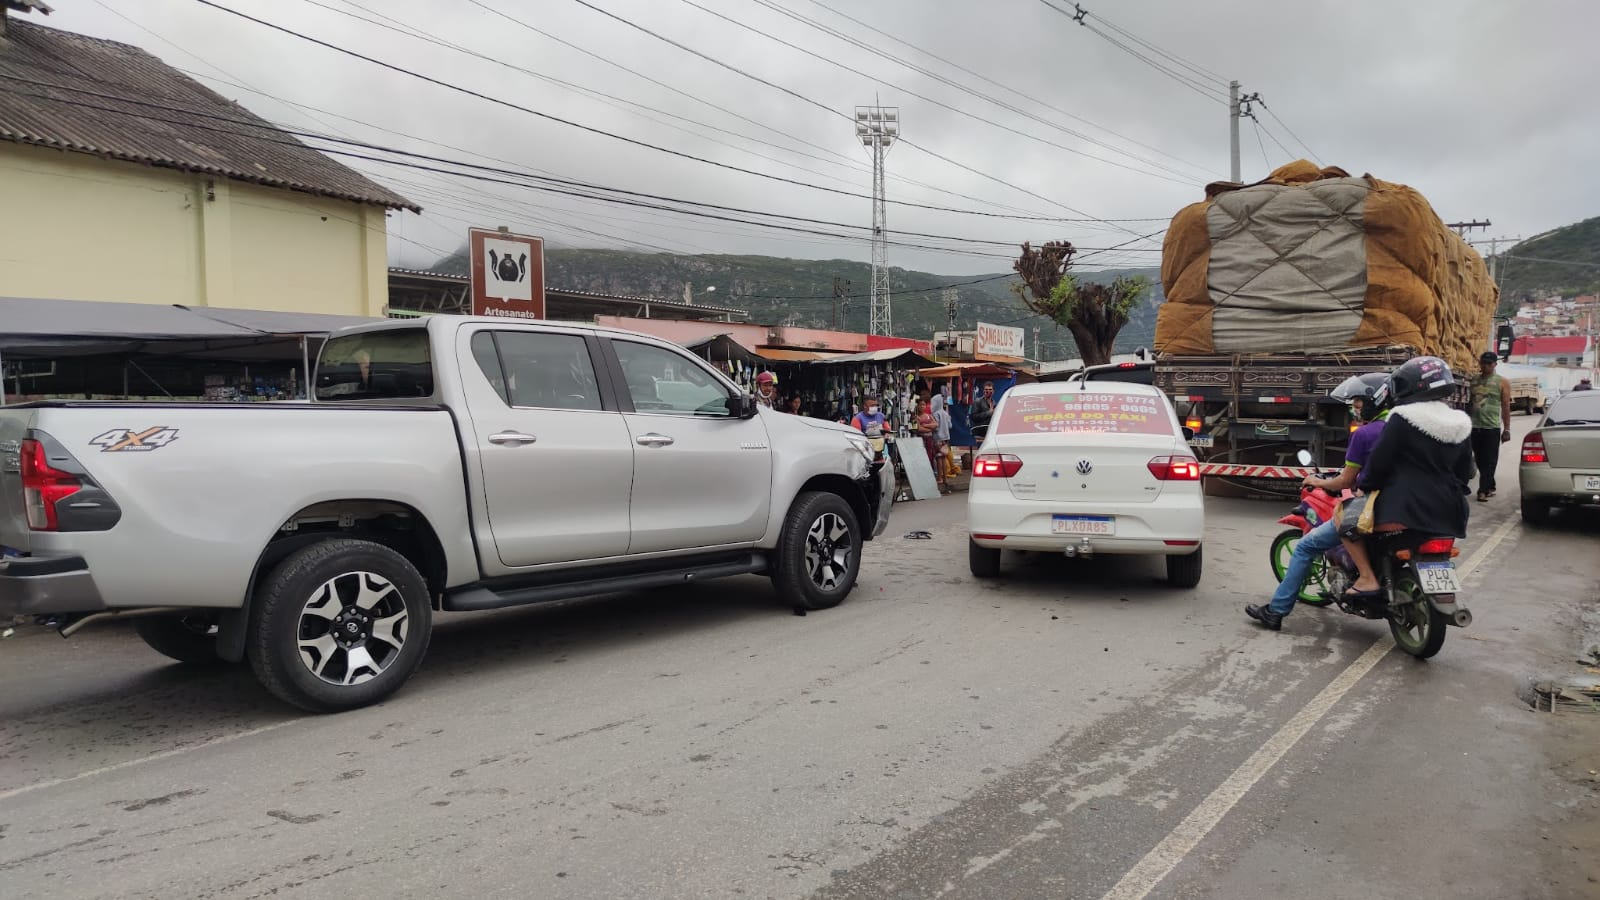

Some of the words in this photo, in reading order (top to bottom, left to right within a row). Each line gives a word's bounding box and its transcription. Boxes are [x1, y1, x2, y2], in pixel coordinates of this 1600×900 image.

[484, 306, 535, 319] Artesanato
[978, 326, 1014, 349] SANGALO'S
[1081, 412, 1105, 420] DO
[1426, 580, 1457, 591] 5171
